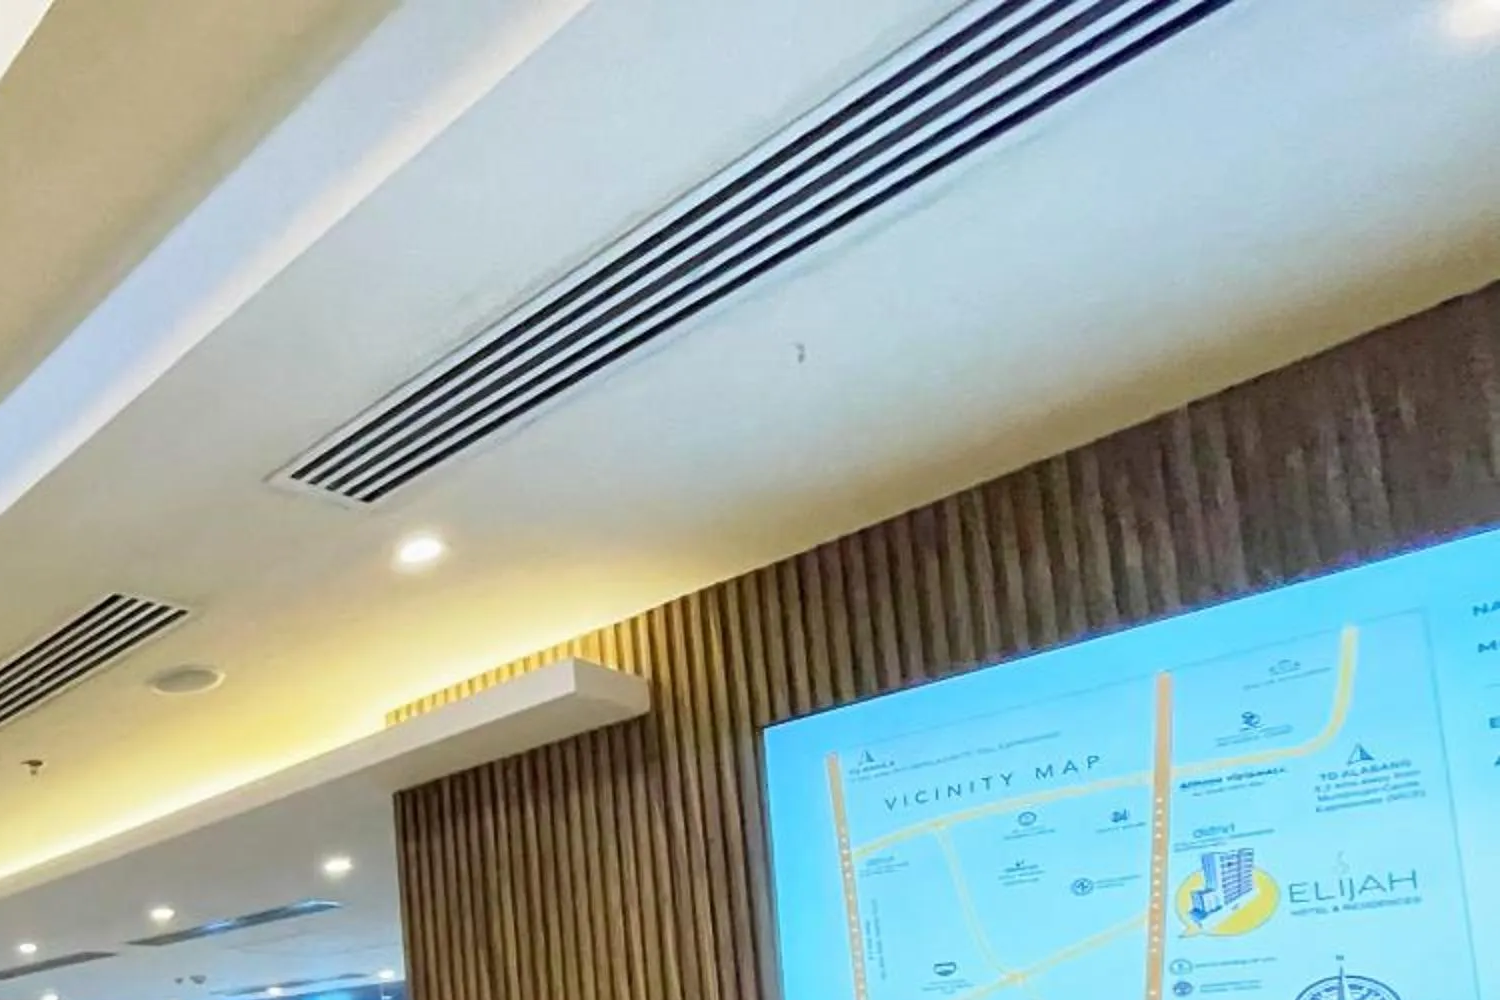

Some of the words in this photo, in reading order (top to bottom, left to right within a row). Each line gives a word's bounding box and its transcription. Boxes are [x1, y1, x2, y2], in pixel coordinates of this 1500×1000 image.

[884, 772, 1014, 811] VICINITY
[1035, 755, 1101, 779] MAP
[1288, 869, 1418, 903] ELIJAH
